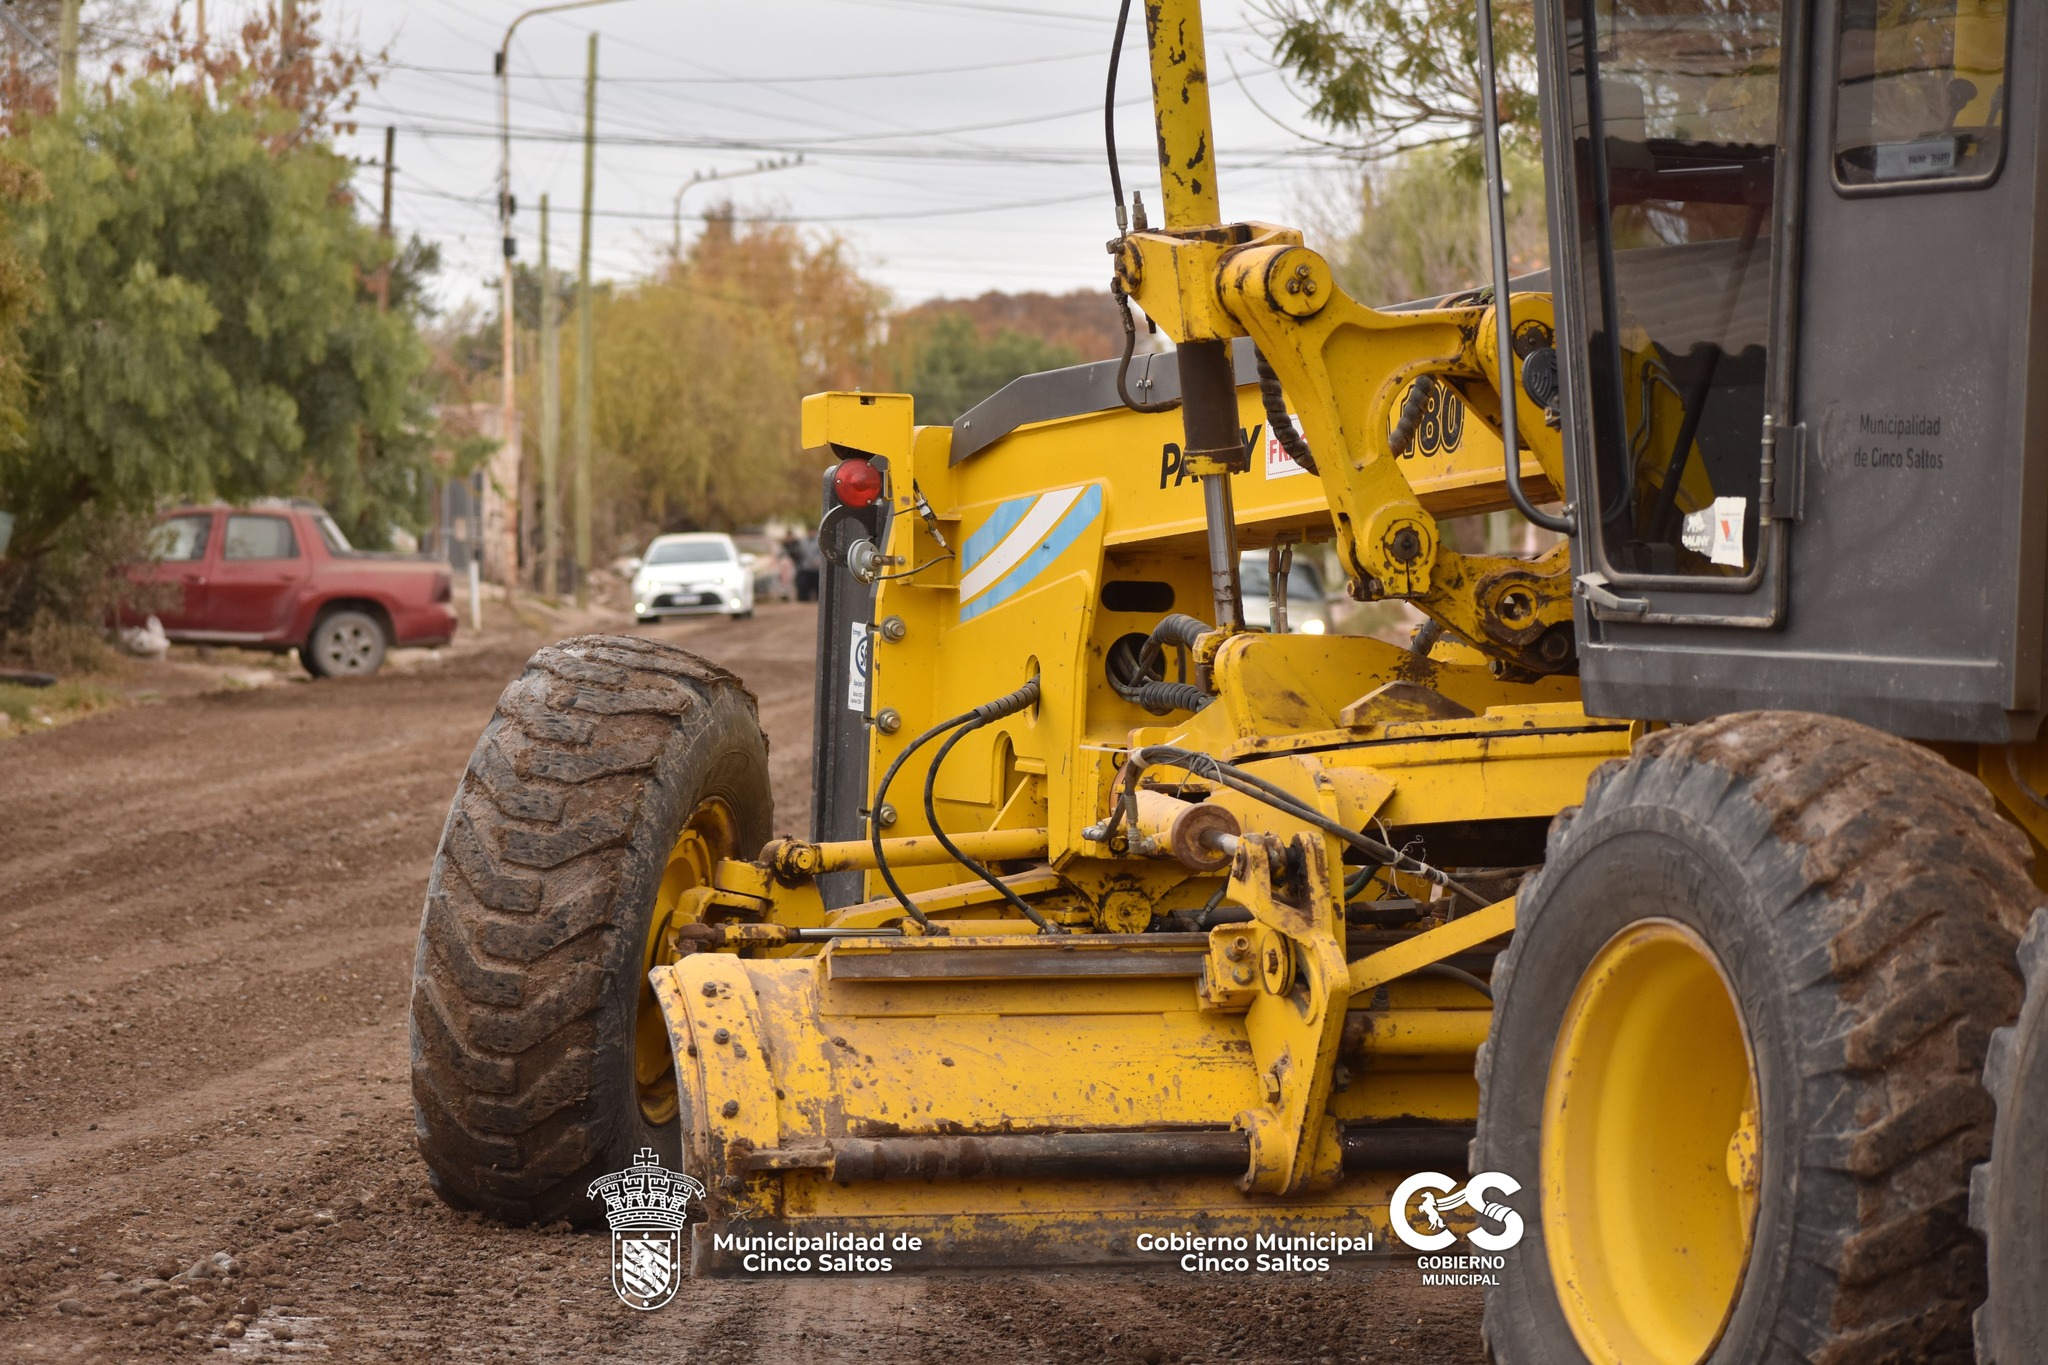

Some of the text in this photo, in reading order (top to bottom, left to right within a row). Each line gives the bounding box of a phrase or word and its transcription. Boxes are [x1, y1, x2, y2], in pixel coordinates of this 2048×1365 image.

[1860, 413, 1942, 440] Municipalidad
[1853, 446, 1944, 470] de Cinco Saltos
